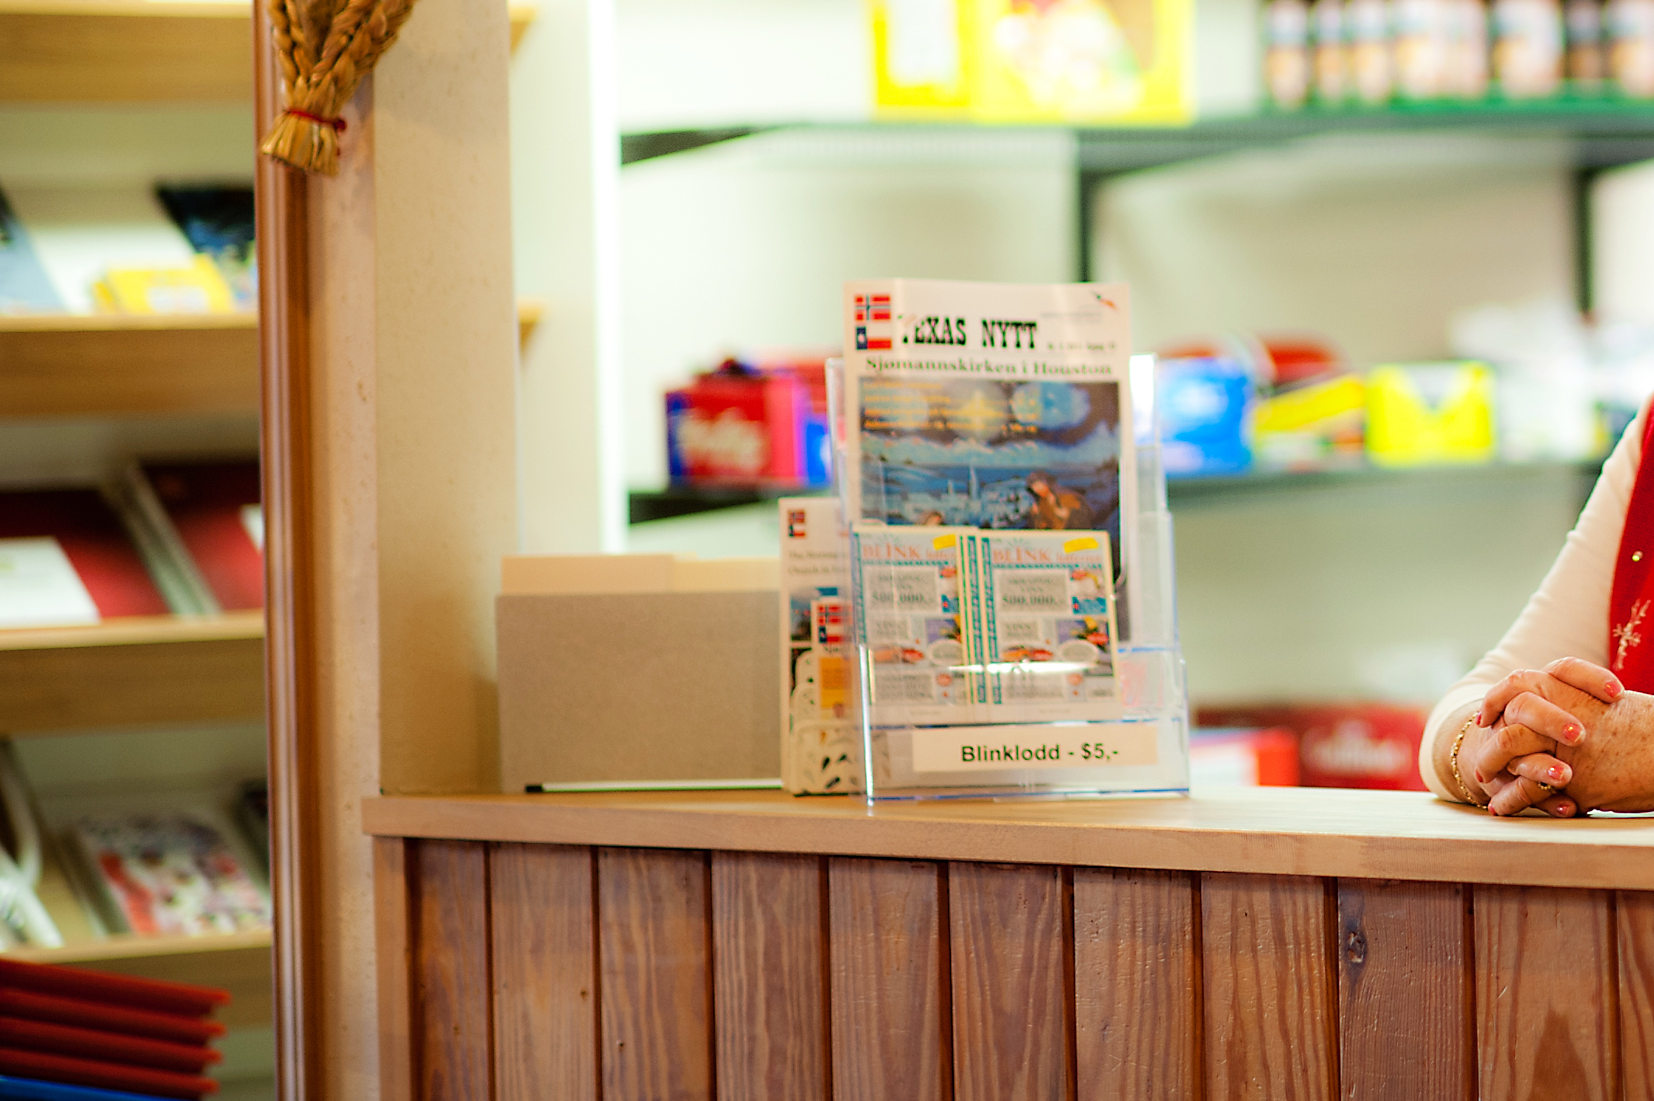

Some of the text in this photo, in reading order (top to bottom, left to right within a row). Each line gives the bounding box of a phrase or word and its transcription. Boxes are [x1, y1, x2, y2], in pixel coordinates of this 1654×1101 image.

[981, 319, 1037, 349] NYTT
[865, 357, 1017, 376] Sjømannskirken
[1034, 362, 1112, 376] Houston
[993, 547, 1052, 563] BLINK
[961, 745, 1060, 762] Blinklodd
[1081, 743, 1119, 762] $5,-
